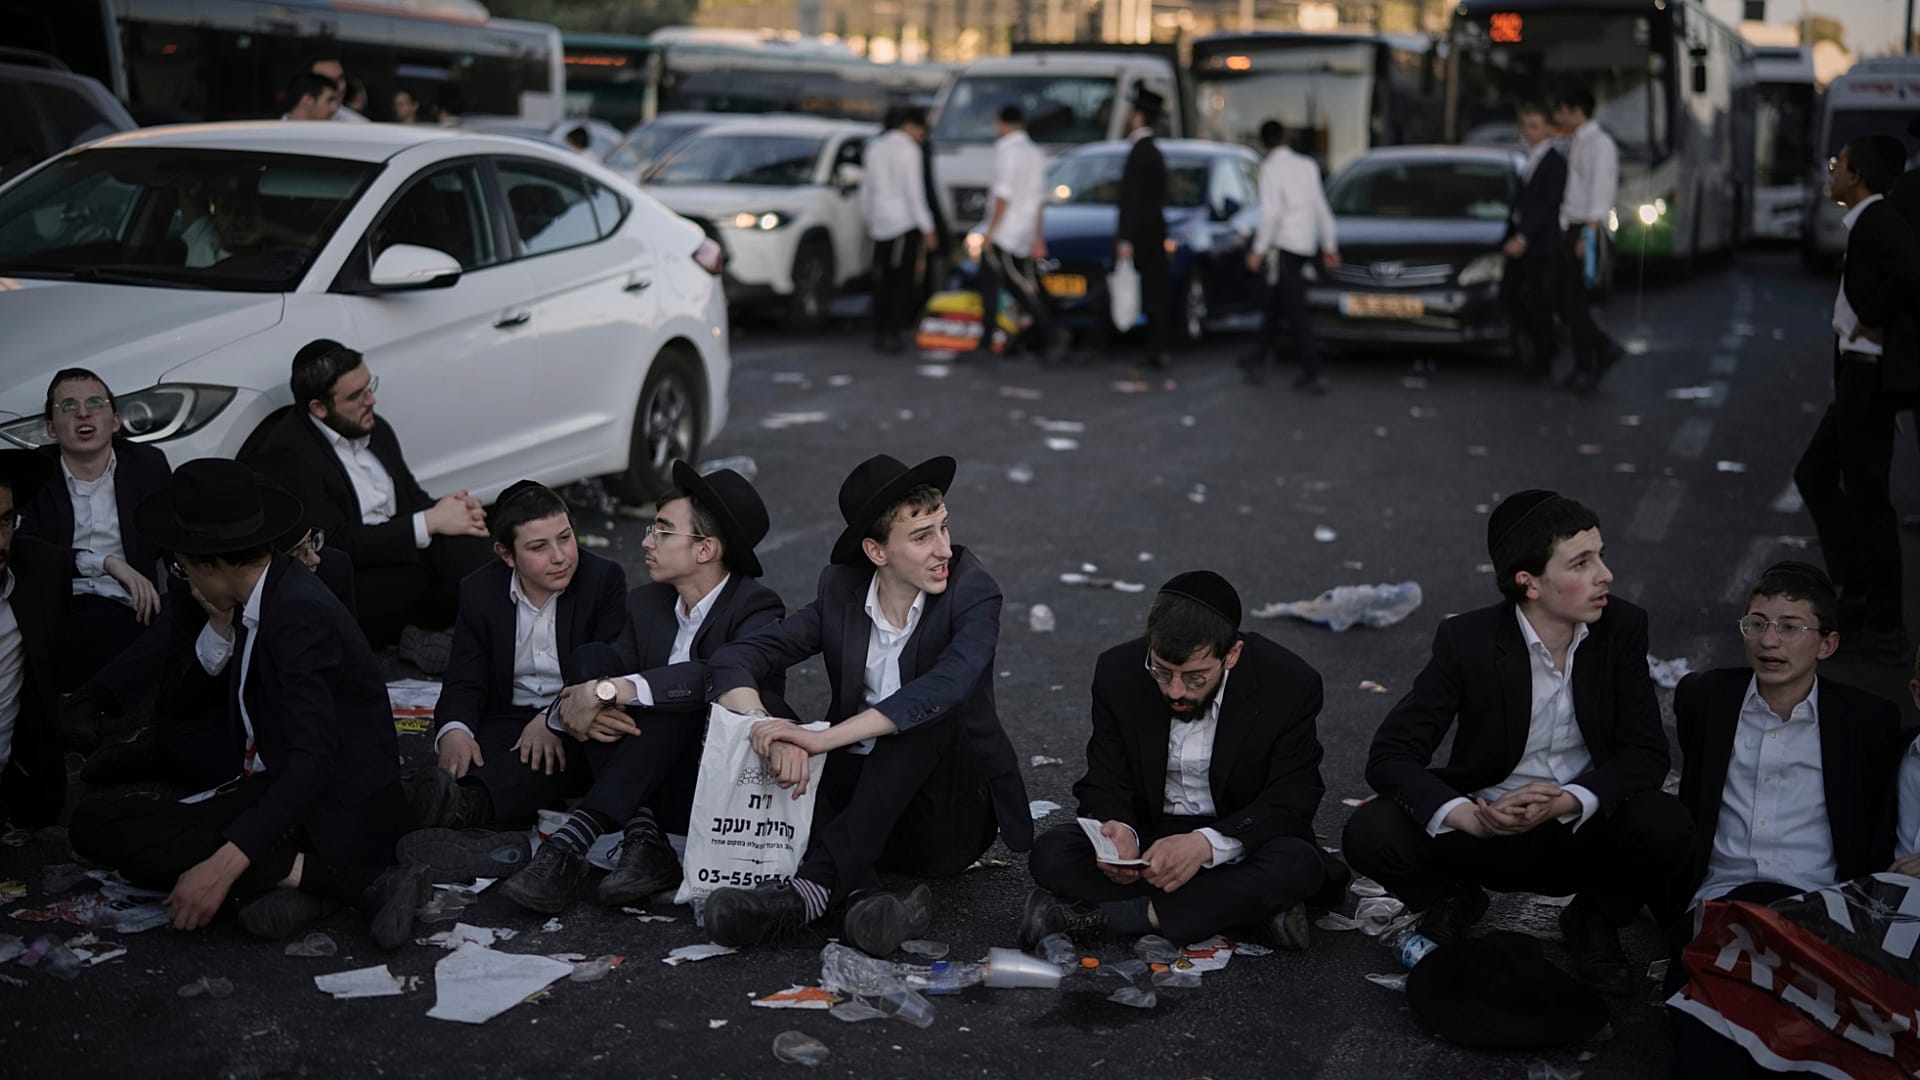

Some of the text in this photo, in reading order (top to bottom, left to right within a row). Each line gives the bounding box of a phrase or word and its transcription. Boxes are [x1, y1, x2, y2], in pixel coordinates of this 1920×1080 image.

[711, 817, 795, 841] קהילת יעקב
[1714, 922, 1920, 1062] צבא
